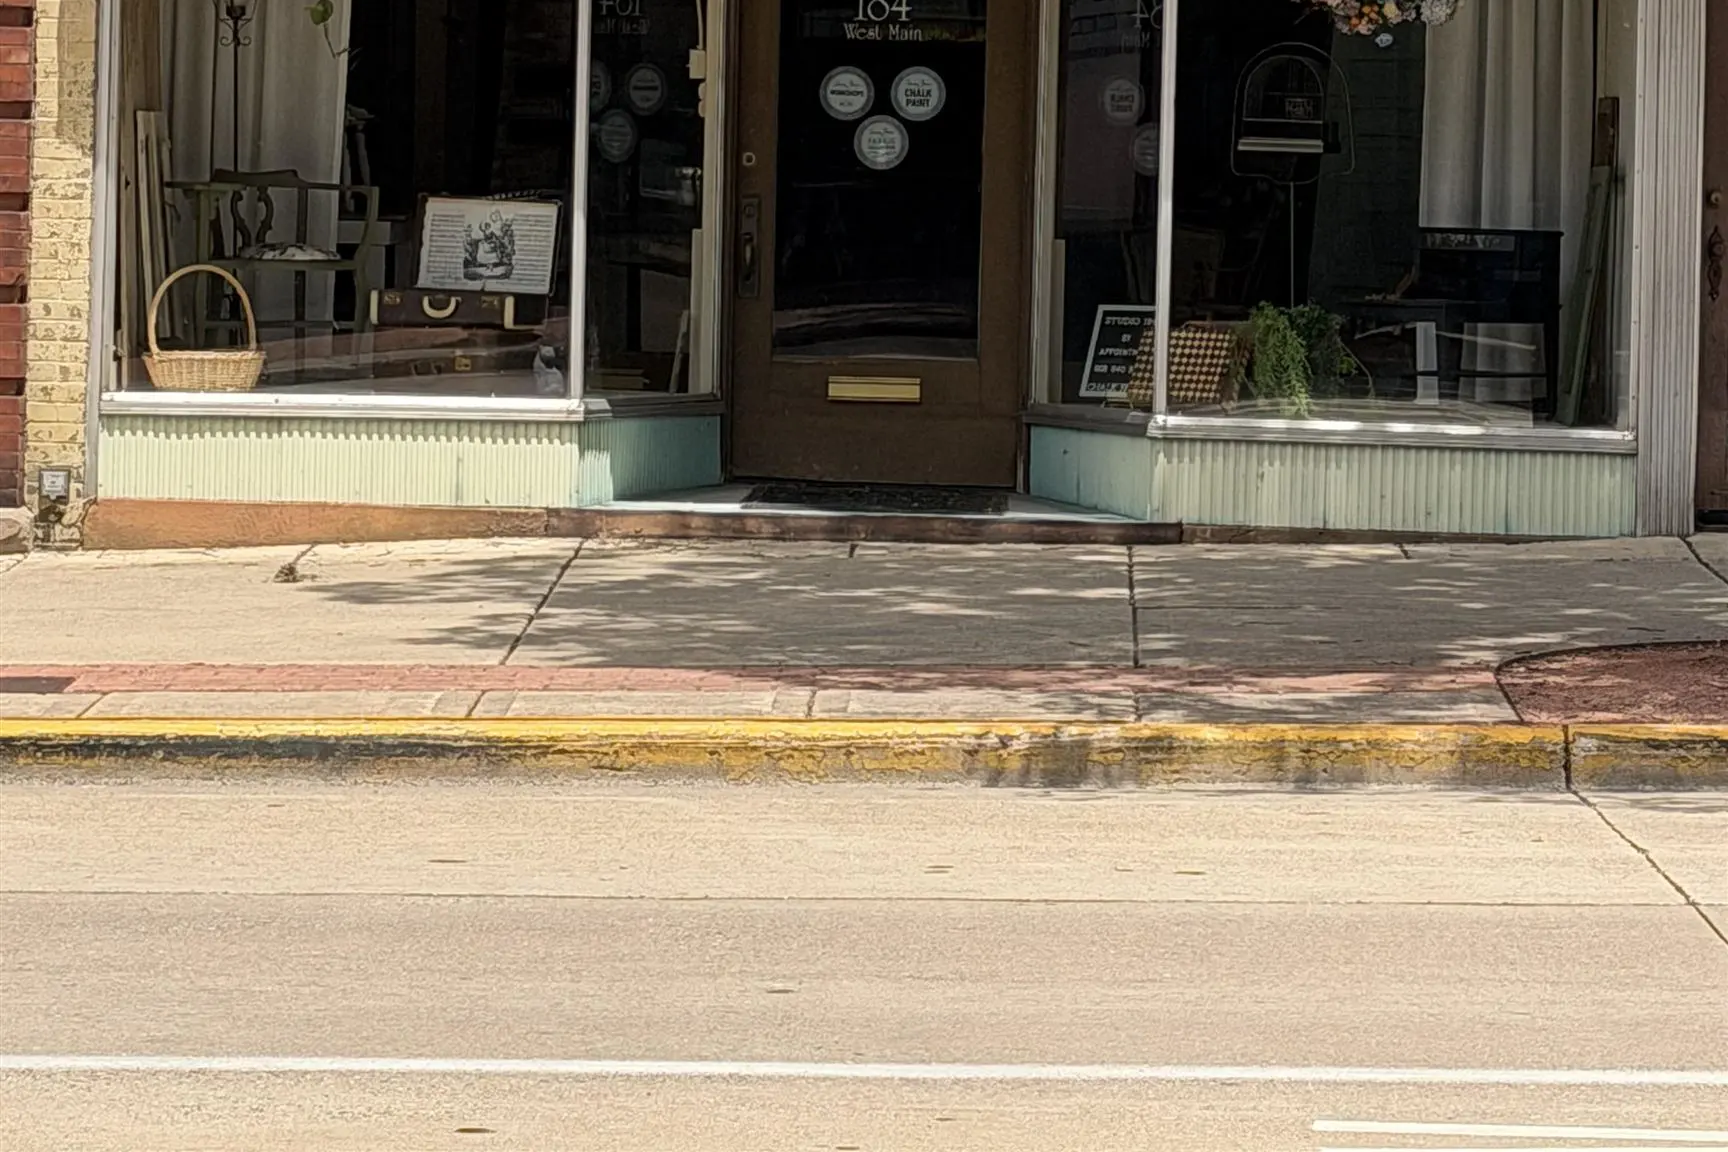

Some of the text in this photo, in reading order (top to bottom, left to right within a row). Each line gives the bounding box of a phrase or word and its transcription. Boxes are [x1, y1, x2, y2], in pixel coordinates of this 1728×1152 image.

[843, 23, 922, 41] West Main
[904, 87, 932, 98] CHALK
[905, 98, 931, 109] PAINT
[1105, 316, 1141, 325] STUDIO
